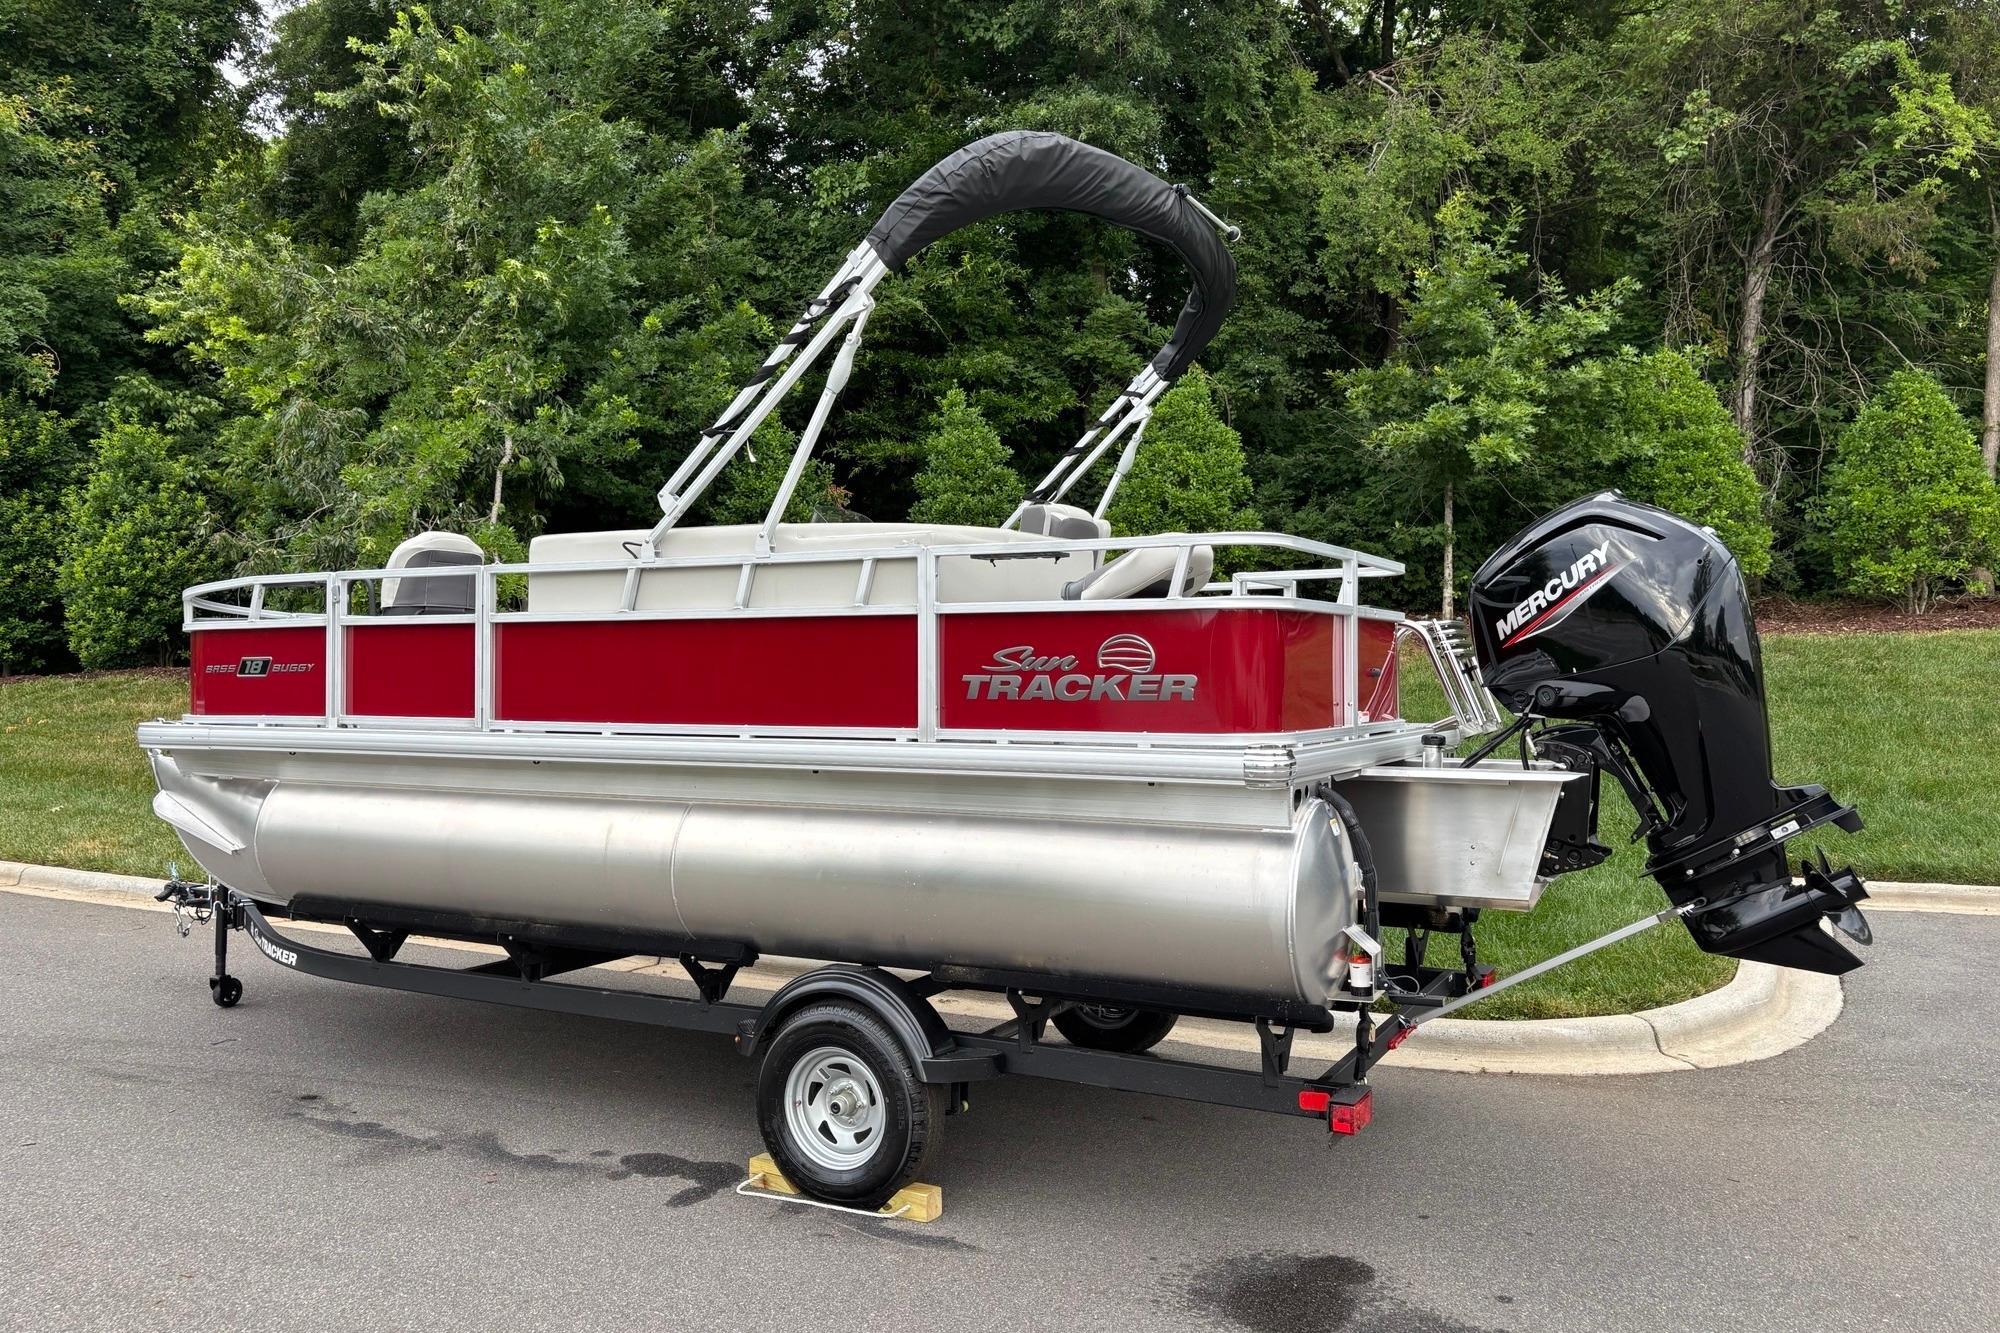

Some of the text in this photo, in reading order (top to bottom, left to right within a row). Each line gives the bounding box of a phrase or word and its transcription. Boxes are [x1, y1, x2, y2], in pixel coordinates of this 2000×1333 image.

[1496, 540, 1610, 641] MERCURY
[205, 660, 315, 674] BASS 18 BUGGY
[981, 645, 1079, 673] Sun
[962, 674, 1198, 701] TRACKER
[261, 936, 298, 966] TRACKER
